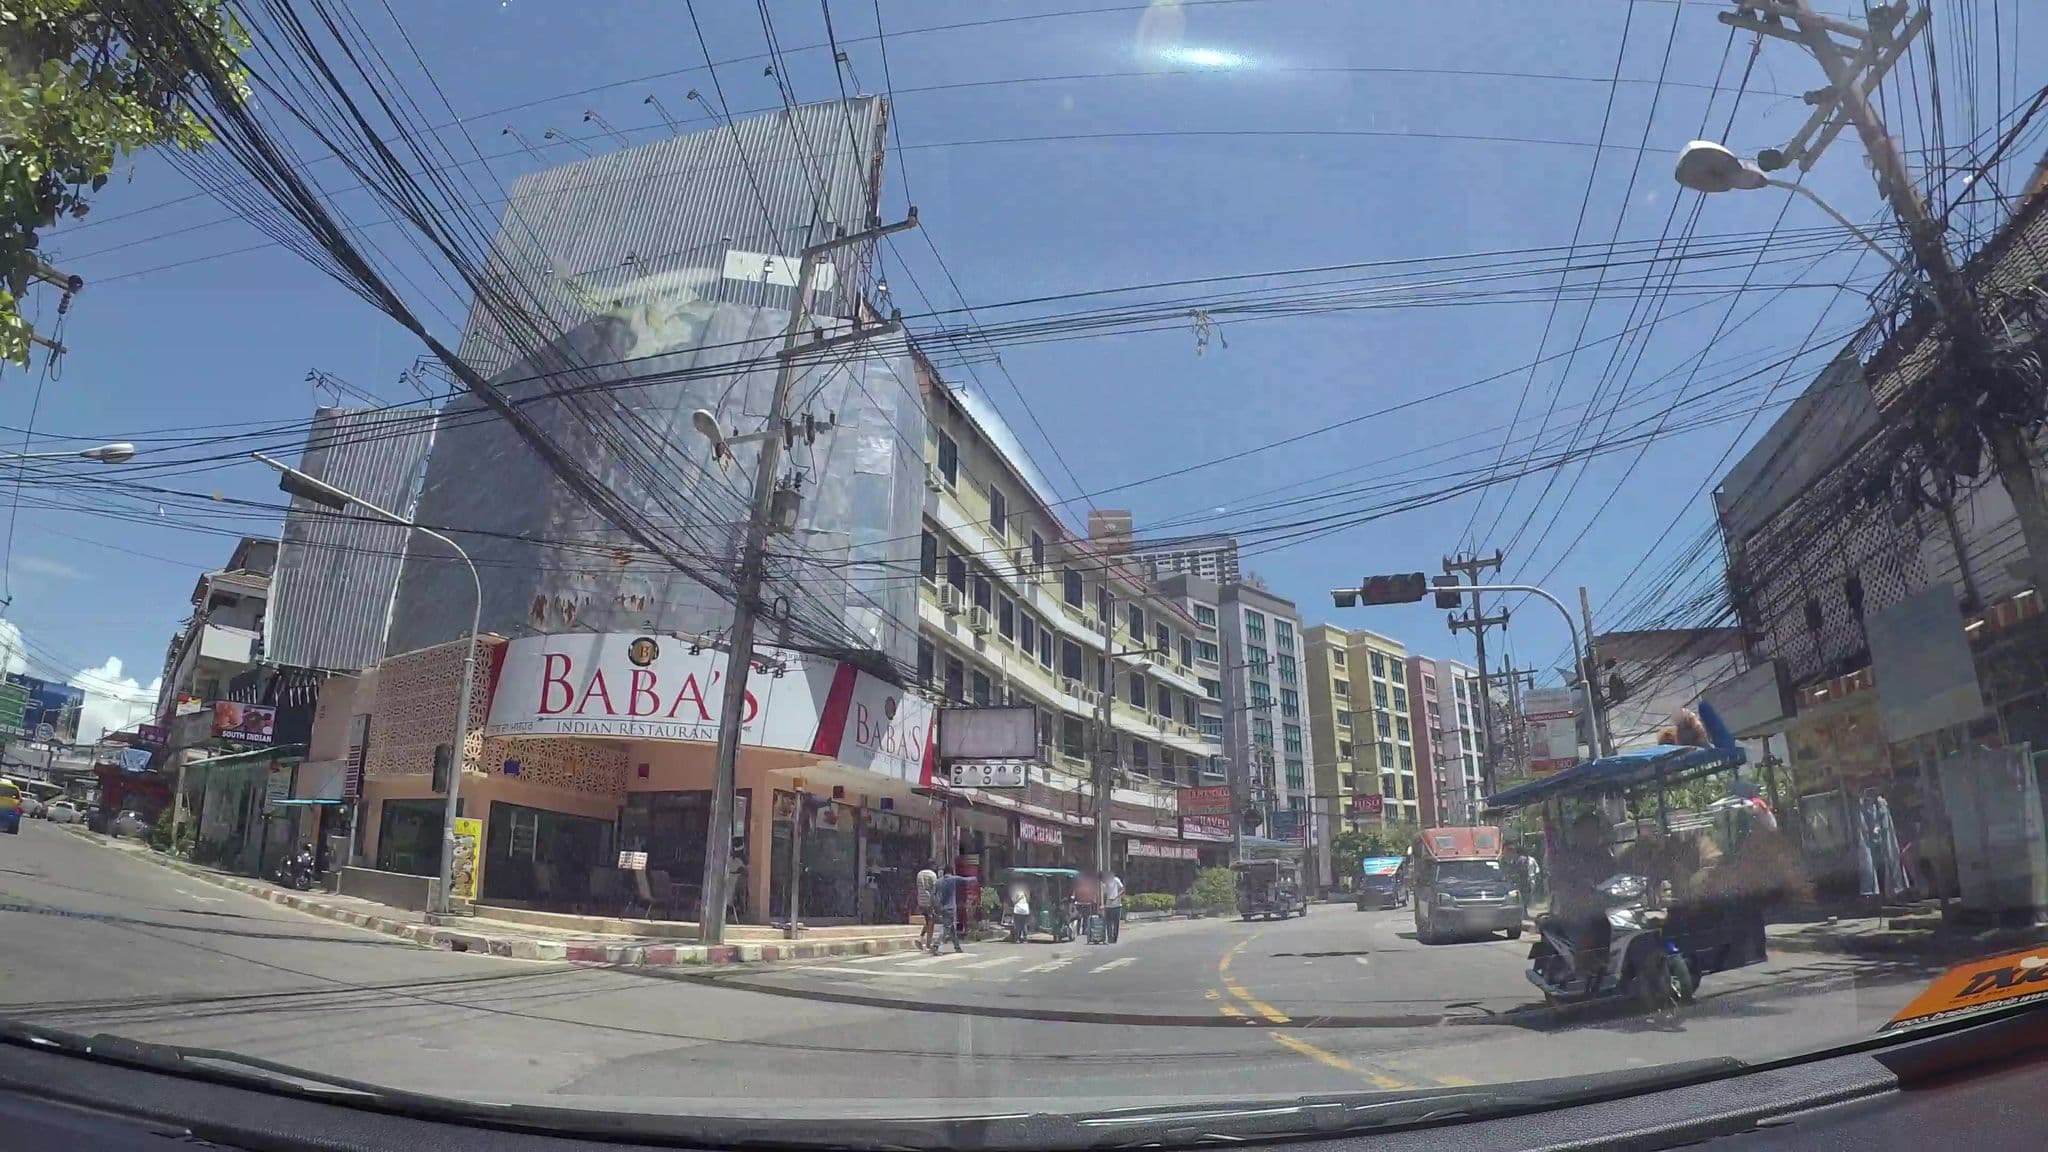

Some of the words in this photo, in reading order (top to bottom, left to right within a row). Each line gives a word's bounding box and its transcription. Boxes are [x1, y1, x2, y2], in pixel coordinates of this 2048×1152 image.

[556, 720, 613, 735] INDIAN
[856, 702, 921, 762] BABA'S
[222, 730, 245, 740] SOUTH
[246, 733, 272, 743] INDIAN
